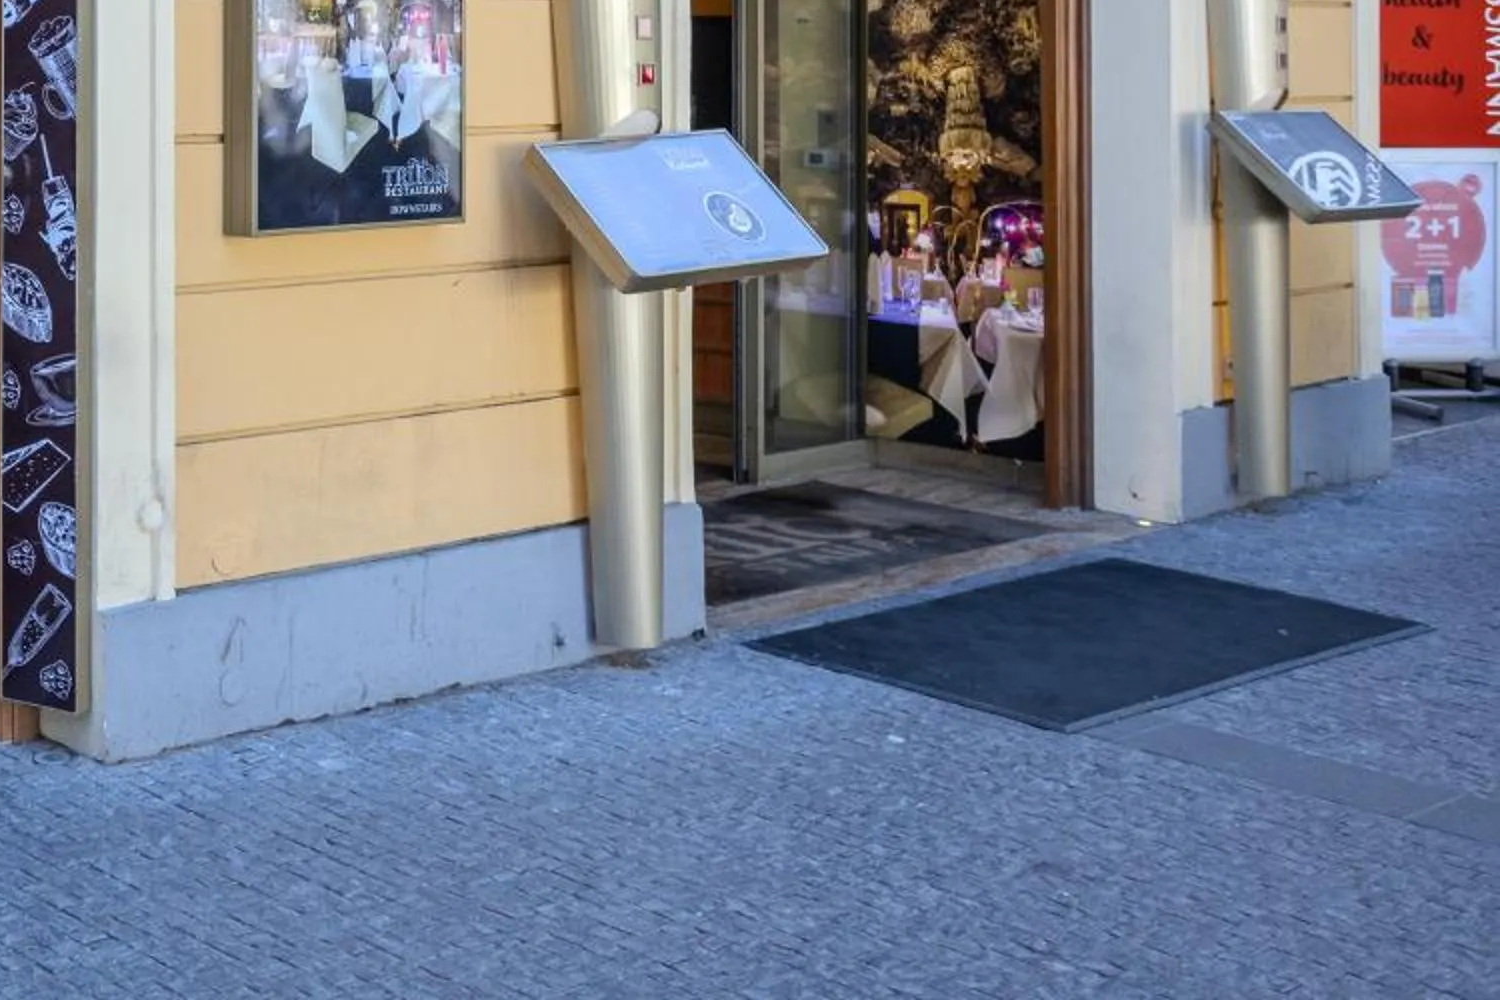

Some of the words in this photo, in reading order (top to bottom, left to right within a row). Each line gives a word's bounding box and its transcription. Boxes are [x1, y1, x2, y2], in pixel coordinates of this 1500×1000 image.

[1411, 24, 1433, 50] &
[1382, 63, 1465, 95] beauty
[382, 157, 449, 186] TRITON
[385, 183, 449, 197] RESTAURANT
